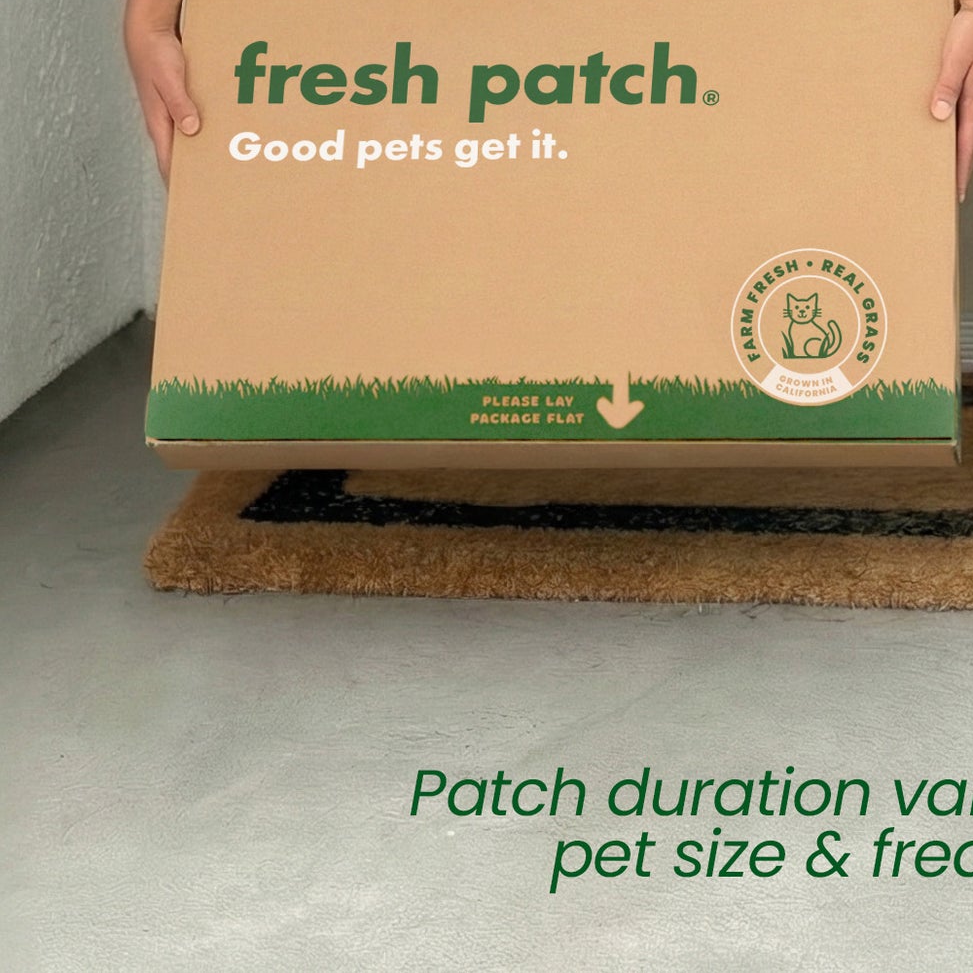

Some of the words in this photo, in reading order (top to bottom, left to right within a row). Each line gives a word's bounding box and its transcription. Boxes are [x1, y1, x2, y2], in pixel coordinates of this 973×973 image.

[235, 41, 438, 105] fresh
[228, 129, 345, 162] Good
[356, 134, 443, 169] pets
[454, 133, 521, 168] get
[531, 128, 568, 160] it.
[747, 259, 799, 304] FRESH
[821, 259, 865, 295] REAL
[740, 308, 761, 363] FARM
[856, 298, 879, 364] GRASS
[776, 383, 837, 397] CALIFORNIA
[779, 375, 819, 387] GROWN
[822, 376, 833, 386] IN
[470, 412, 541, 425] PACKAGE
[546, 412, 585, 425] FLAT
[482, 395, 540, 408] PLEASE
[545, 395, 574, 408] LAY
